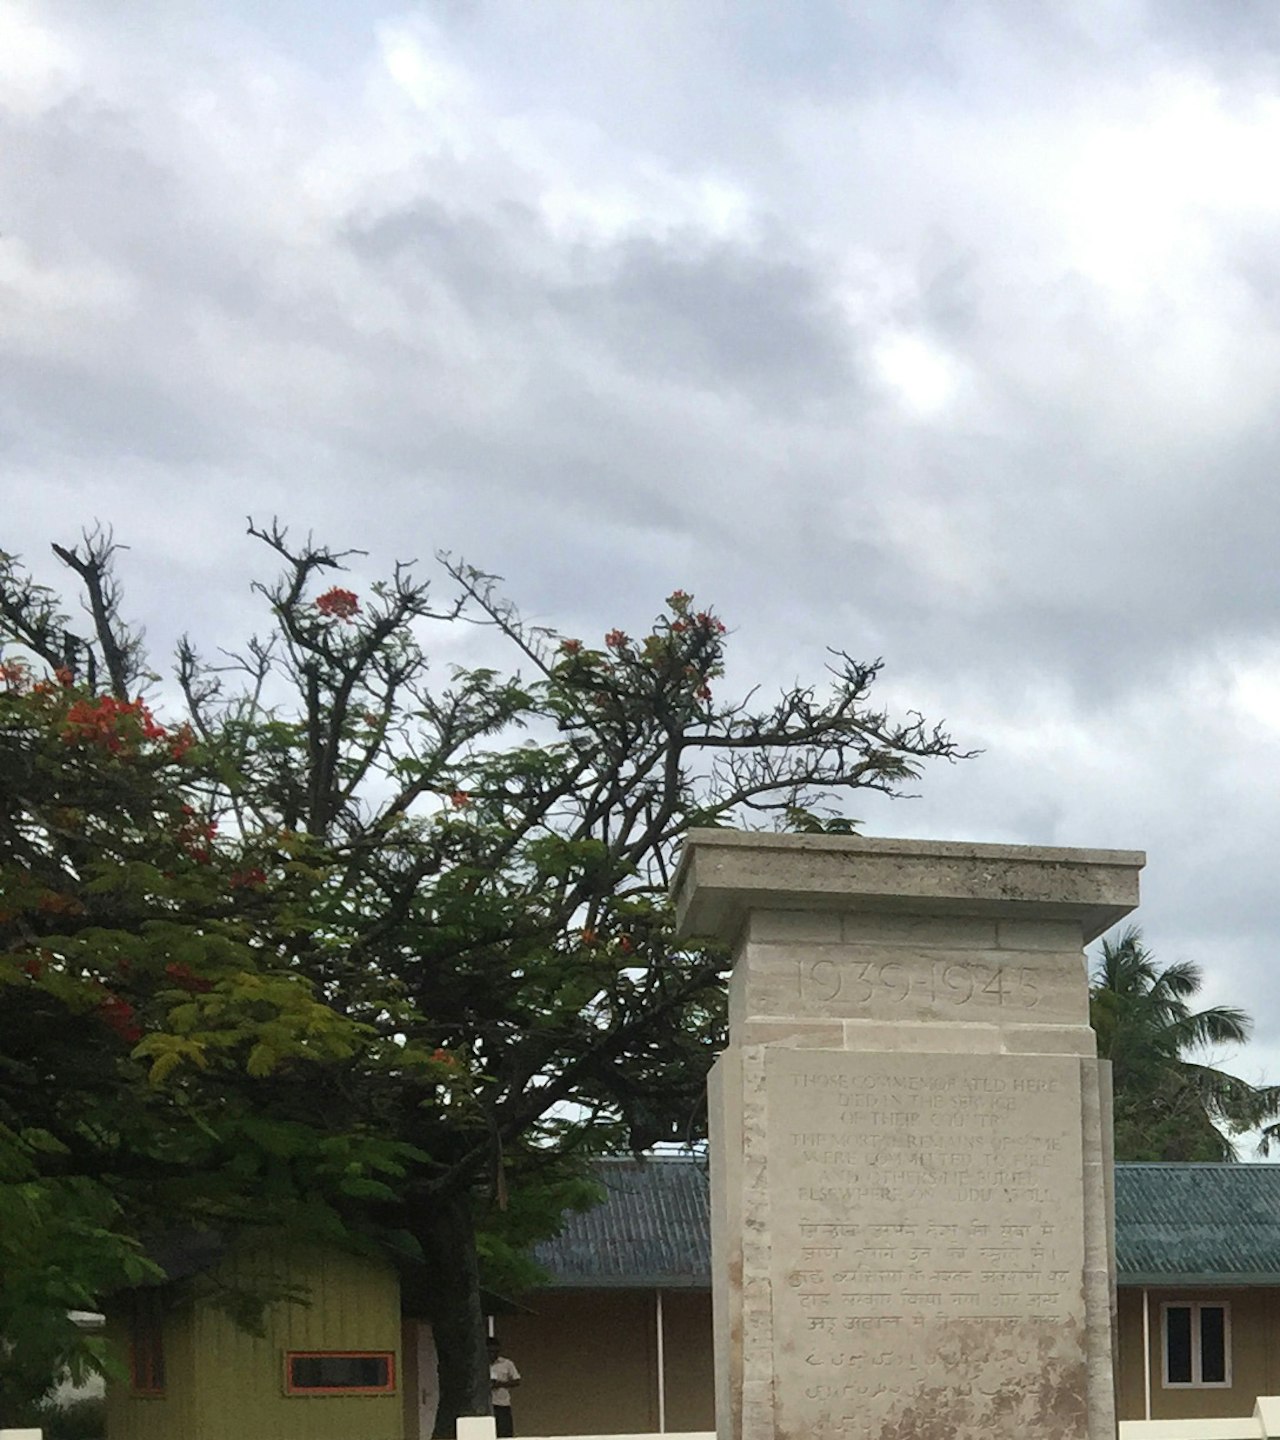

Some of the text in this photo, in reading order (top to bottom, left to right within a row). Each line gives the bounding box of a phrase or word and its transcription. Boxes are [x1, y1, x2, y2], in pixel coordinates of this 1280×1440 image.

[795, 960, 1041, 1008] 1939-1945
[790, 1073, 849, 1089] THOSE
[1012, 1077, 1060, 1094] HERE
[837, 1093, 878, 1108] DIED
[881, 1094, 903, 1108] IN
[910, 1095, 944, 1109] THE
[840, 1111, 863, 1126] OF
[870, 1111, 921, 1128] THEIR
[790, 1132, 829, 1147] THE
[906, 1135, 984, 1151] REMAINS
[802, 1150, 858, 1165] WERE
[982, 1152, 1005, 1167] TO
[818, 1168, 860, 1185] AND
[797, 1187, 905, 1203] ELSEWHERE
[946, 1188, 993, 1204] DDU
